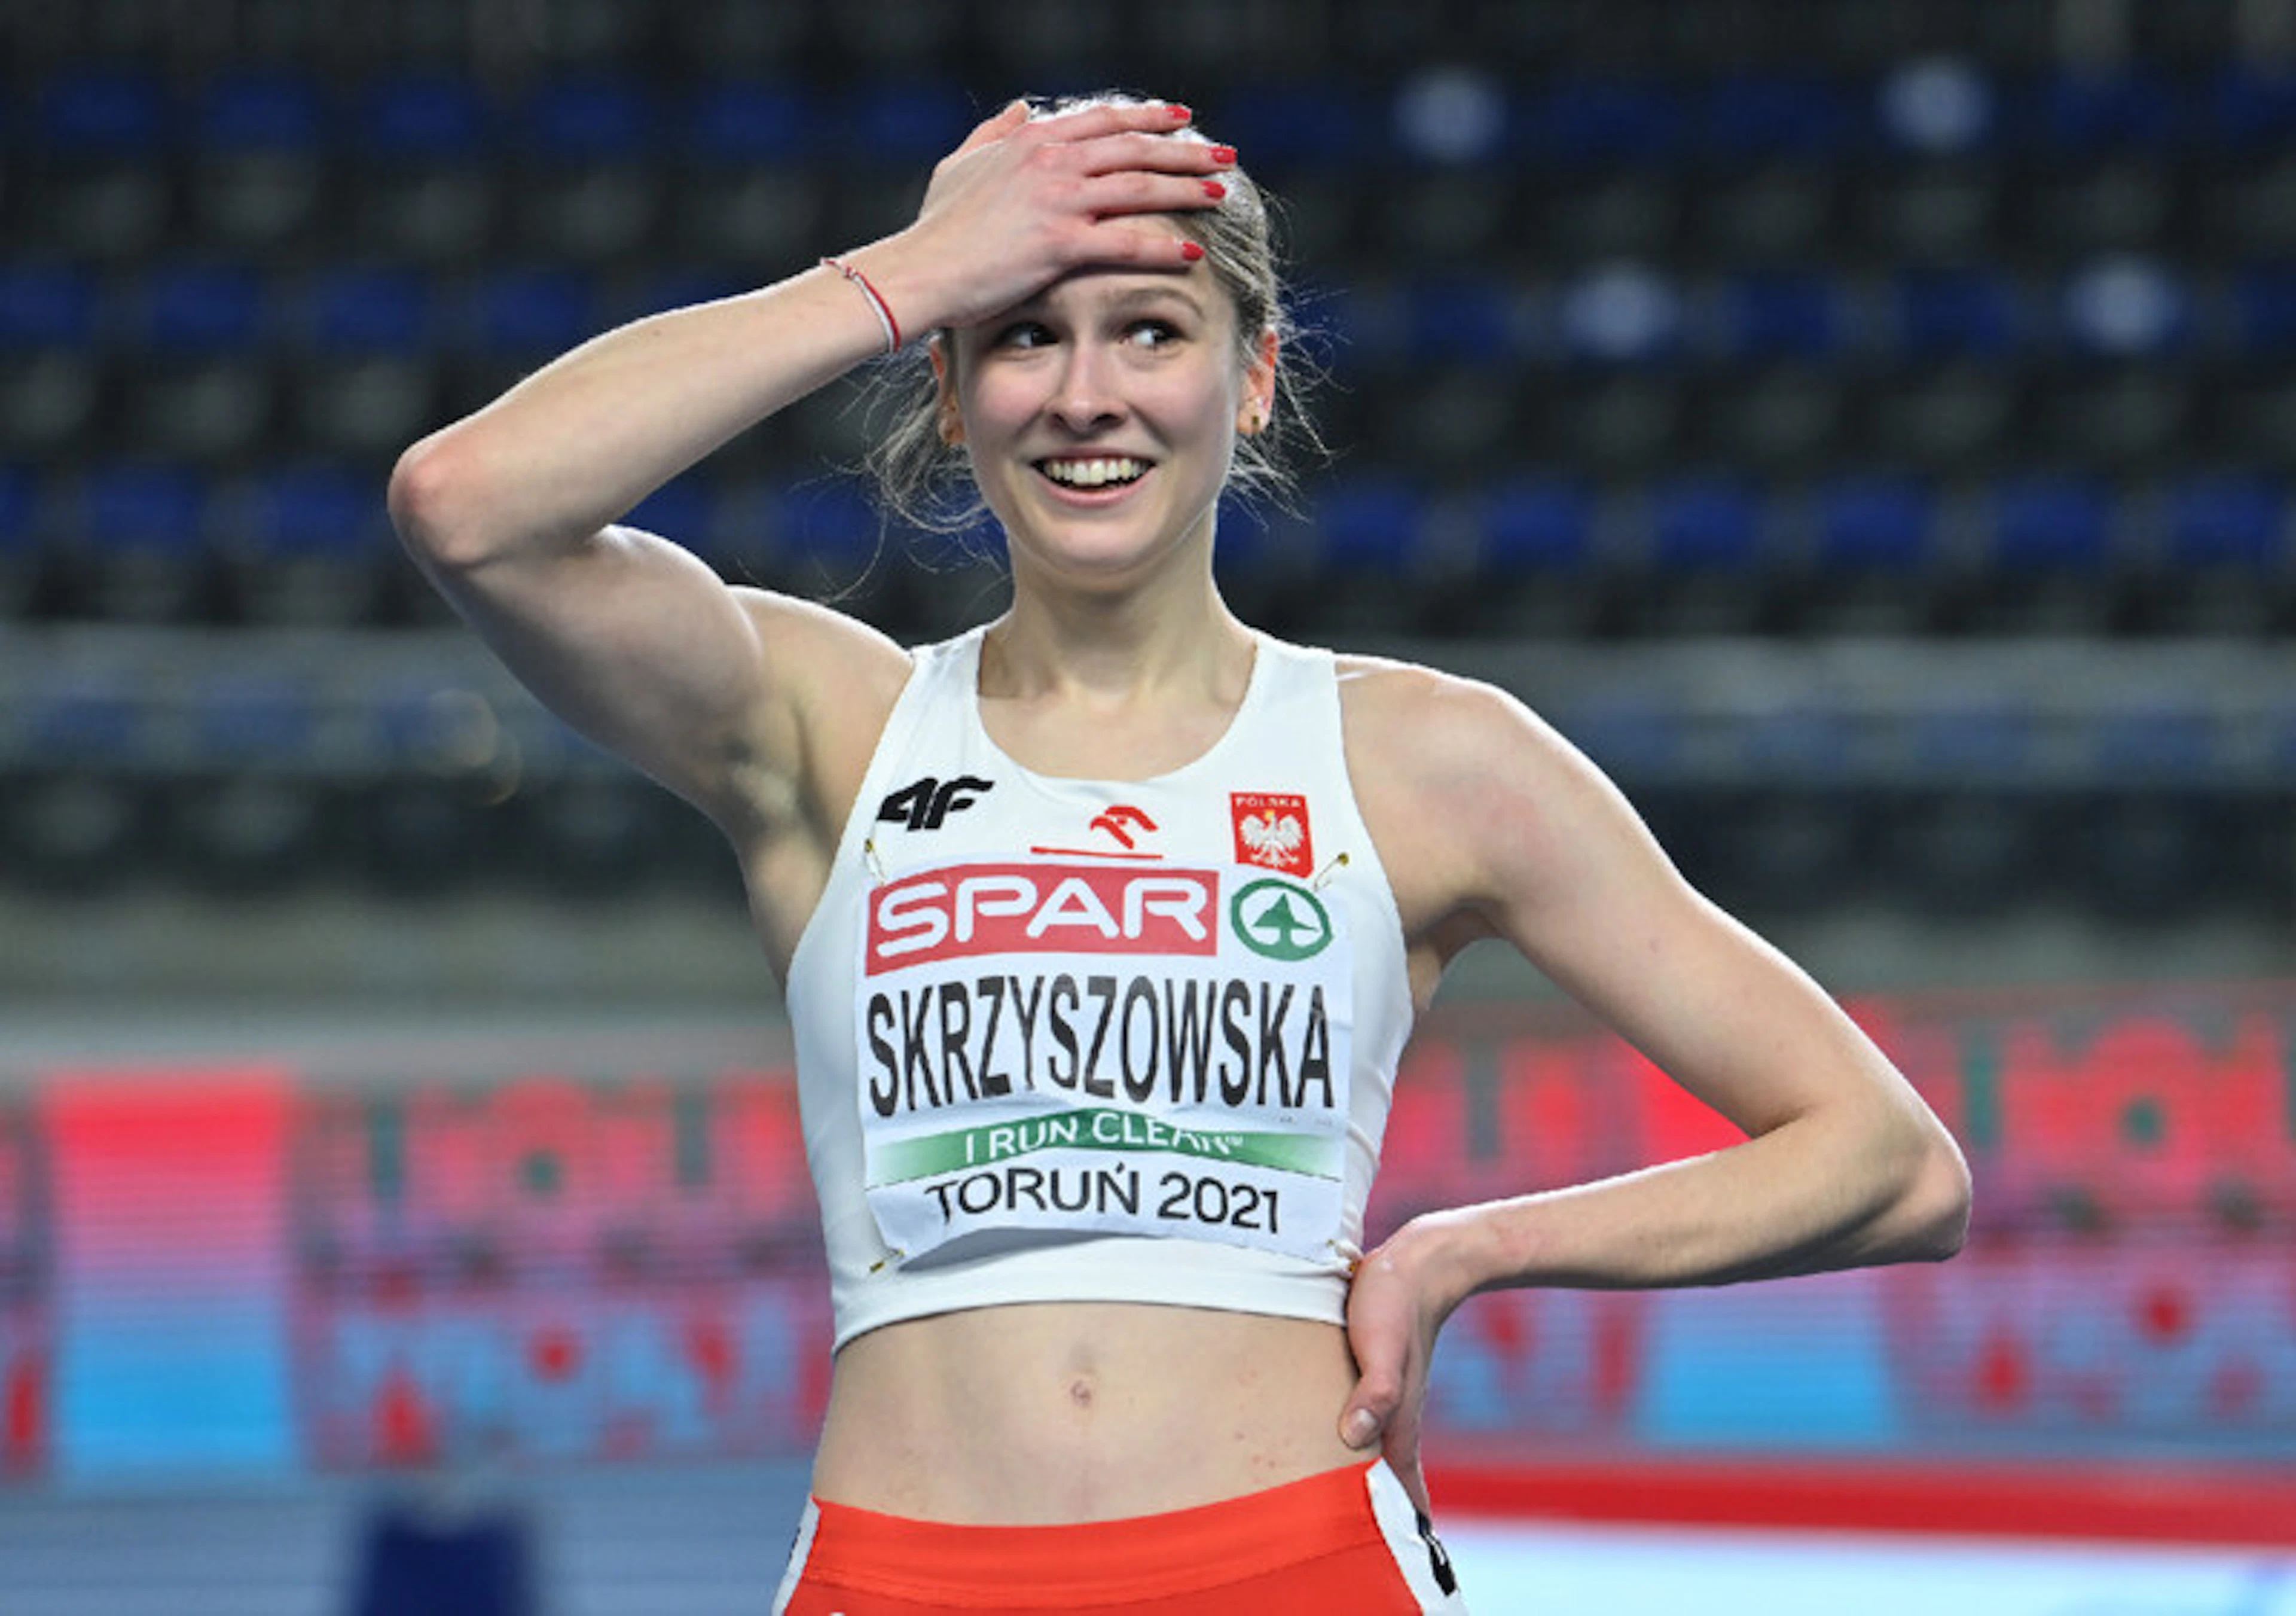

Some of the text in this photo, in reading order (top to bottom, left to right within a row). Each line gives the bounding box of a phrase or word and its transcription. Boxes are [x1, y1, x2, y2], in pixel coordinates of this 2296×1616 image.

[876, 776, 995, 831] 4F
[1235, 796, 1302, 807] POLSKA
[875, 876, 1207, 958] SPAR
[866, 974, 1335, 1117] SKRZYSZOWSKA
[966, 1135, 975, 1163] I
[988, 1120, 1078, 1159] RUN
[924, 1162, 1280, 1234] TORUŃ 2021
